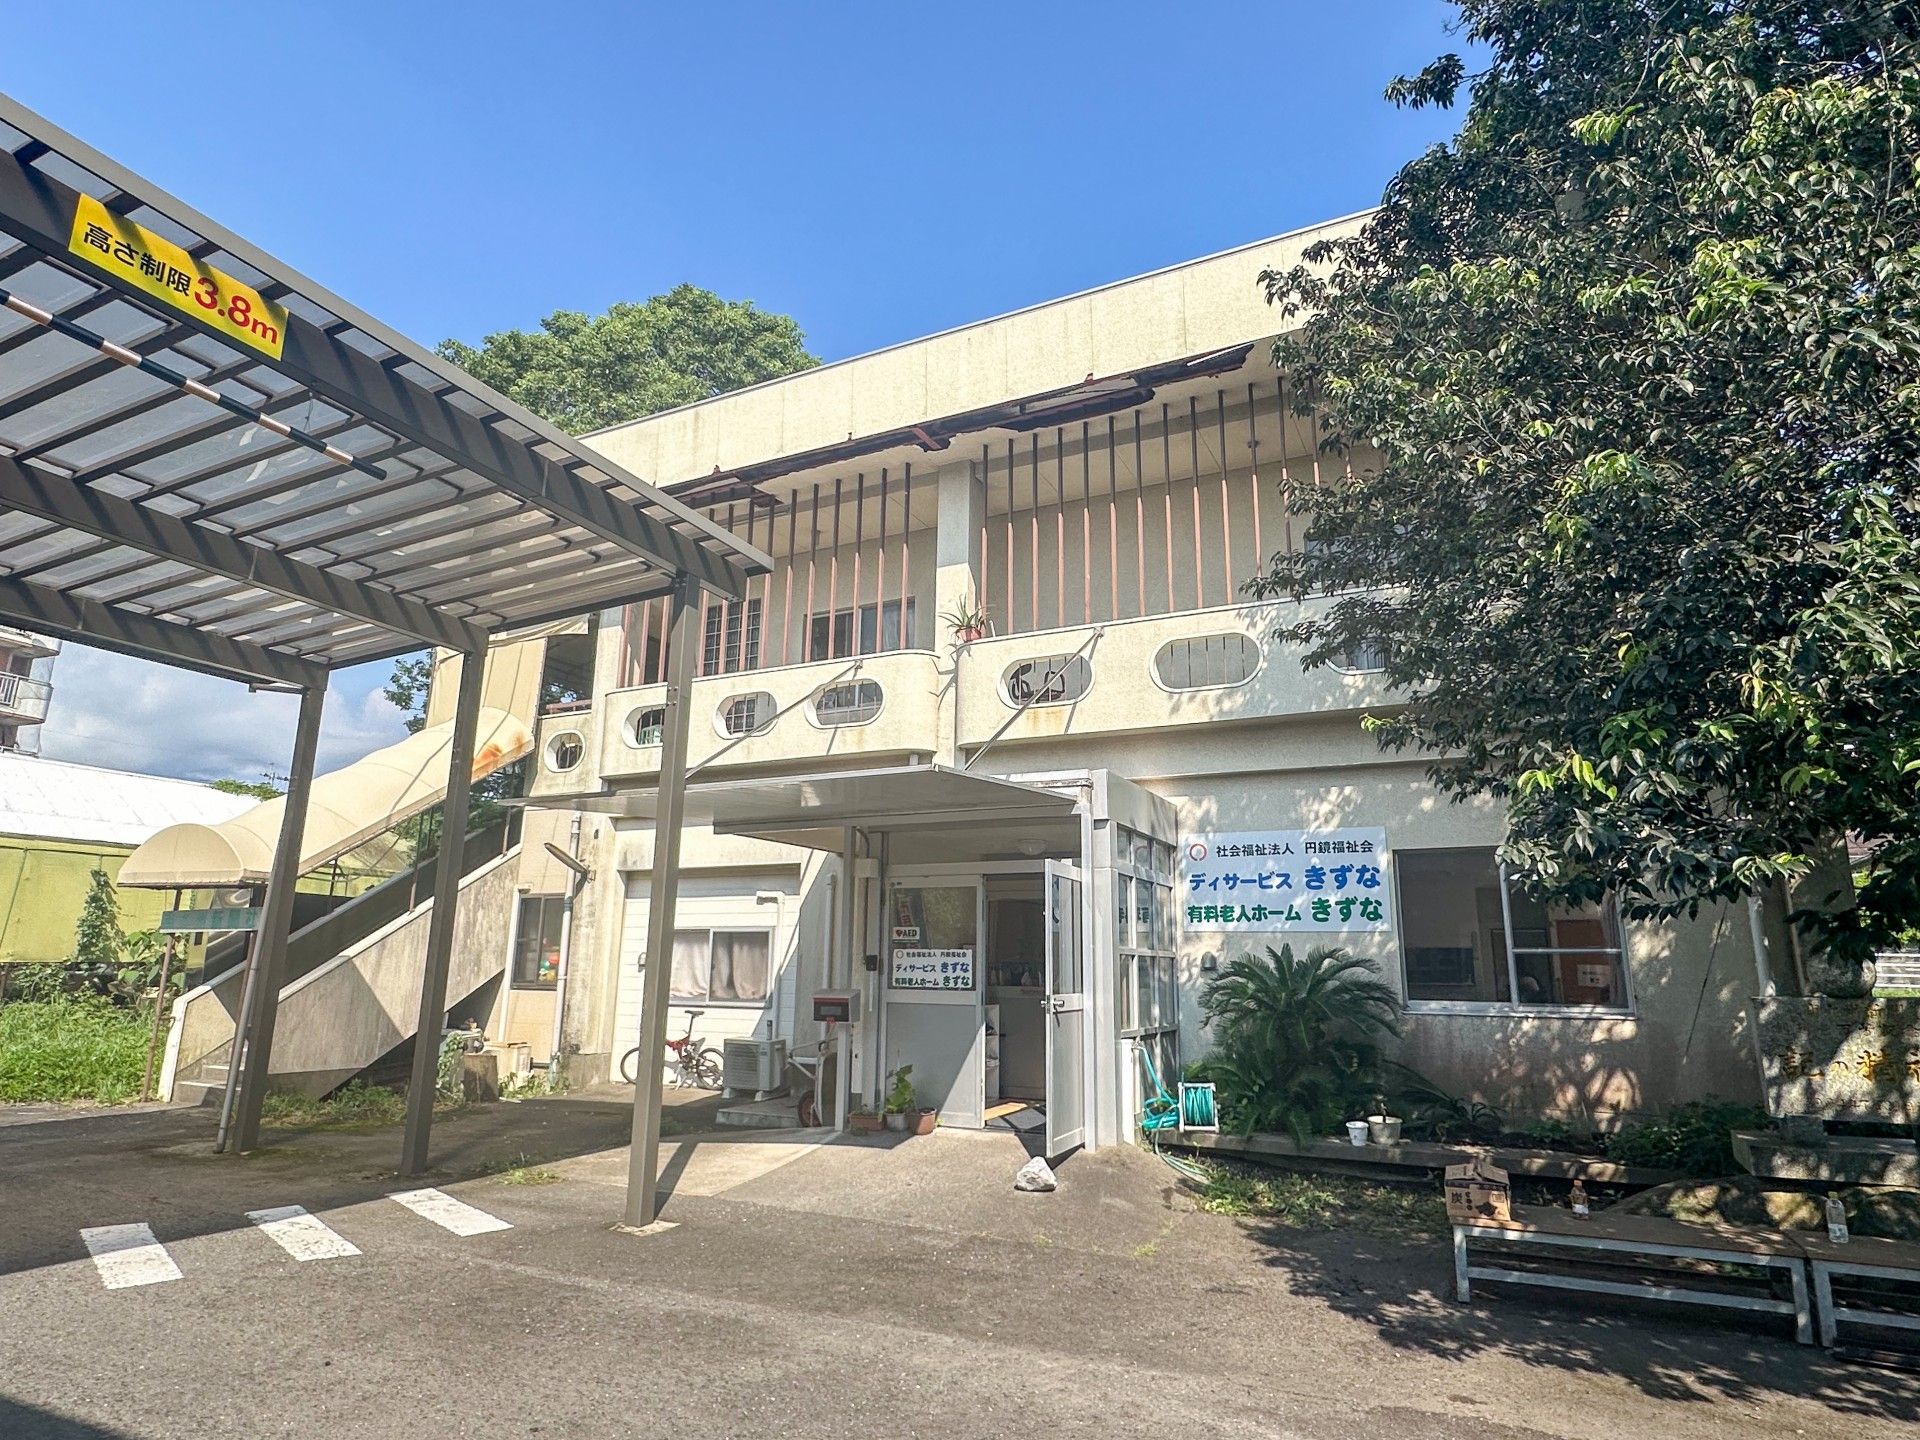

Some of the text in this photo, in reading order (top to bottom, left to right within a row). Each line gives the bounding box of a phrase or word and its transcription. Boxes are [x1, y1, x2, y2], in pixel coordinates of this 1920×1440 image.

[1216, 840, 1374, 858] 社会福祉法人 円鏡福祉会
[1304, 864, 1381, 890] きずな
[1187, 896, 1383, 923] 有料老人ホーム きずな
[903, 929, 917, 938] AED
[940, 962, 970, 973] きずな
[942, 975, 970, 986] きずな
